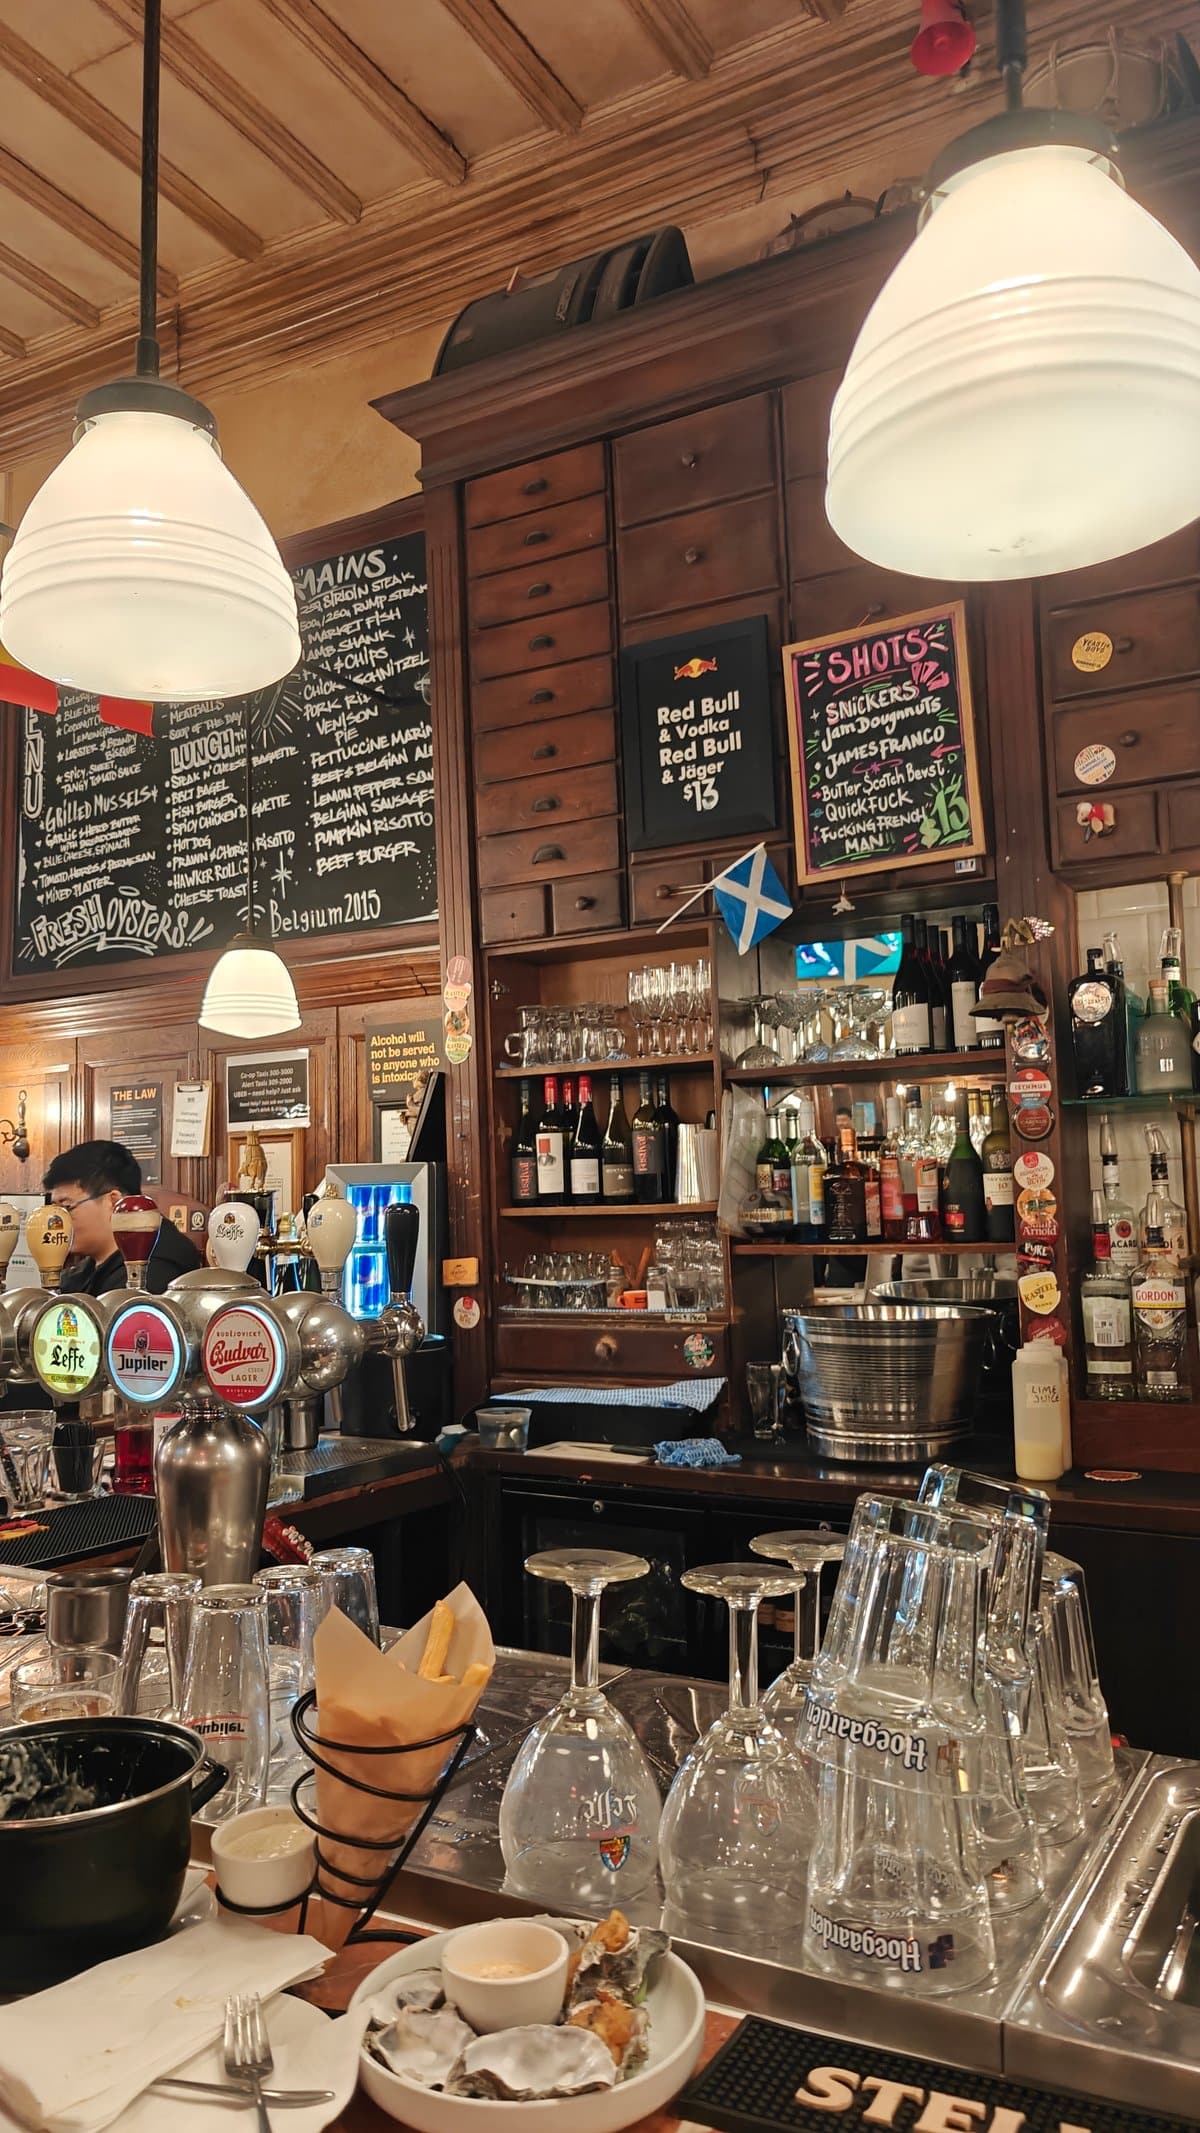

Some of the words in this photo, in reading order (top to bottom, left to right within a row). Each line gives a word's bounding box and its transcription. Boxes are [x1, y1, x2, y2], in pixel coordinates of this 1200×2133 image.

[372, 572, 415, 592] STEAK
[353, 595, 388, 615] RUMP
[388, 584, 428, 602] STEAK
[308, 619, 364, 644] MARKET
[366, 607, 401, 629] FISH
[337, 630, 396, 652] SHANK
[345, 646, 388, 667] CHIPS
[827, 628, 929, 684] SHOTS
[304, 675, 351, 700] CHICK
[353, 651, 430, 685] SCHNITZEL
[170, 701, 224, 724] MEATBALLS
[304, 699, 342, 721] PORK
[657, 700, 695, 725] Red
[701, 690, 740, 716] Bull
[826, 680, 920, 725] SNICKERS
[225, 711, 242, 726] DAY
[316, 705, 378, 735] VENISON
[659, 728, 671, 743] &
[675, 718, 730, 739] Vodka
[335, 727, 359, 746] PIE
[660, 740, 697, 767] Red
[703, 731, 742, 757] Bull
[821, 722, 856, 752] Jam
[24, 705, 44, 819] ENU
[65, 744, 98, 761] LOBSTER
[170, 728, 236, 774] LUNCH
[310, 736, 390, 769] FETTUCCINE
[825, 741, 879, 779] JAMES
[879, 725, 945, 760] FRANCO
[61, 779, 89, 795] TANGY
[117, 762, 142, 778] SAUCE
[312, 768, 345, 787] BEEF
[355, 748, 408, 776] BELGIAN
[661, 769, 674, 784] &
[678, 760, 725, 781] Jäger
[196, 779, 229, 799] BAGEL
[313, 786, 352, 808] LEMON
[352, 777, 404, 800] PEPPER
[683, 777, 719, 812] $13
[821, 781, 862, 802] Butter
[45, 799, 92, 832] GRILLED
[93, 785, 153, 817] MUSSELS
[172, 804, 195, 822] FISH
[195, 792, 238, 815] BURGER
[310, 802, 368, 828] BELGIAN
[45, 827, 77, 848] GARLIC
[171, 819, 198, 836] SPICY
[199, 811, 237, 830] CHICKEN
[315, 819, 371, 852] PUMPKIN
[373, 811, 433, 835] RISOTTO
[42, 854, 63, 868] BLUE
[95, 837, 131, 855] SPINACH
[172, 851, 208, 871] PRAWN
[216, 840, 254, 860] CHORIZ
[255, 830, 296, 851] RISOTTO
[316, 852, 354, 876] BEEF
[356, 841, 420, 866] BURGER
[173, 869, 213, 890] HAWKER
[215, 862, 239, 879] ROLL
[45, 886, 72, 905] MIXED
[72, 876, 115, 897] PLATTER
[174, 889, 214, 909] CHEESE
[215, 880, 258, 901] TOASTE
[30, 893, 106, 957] FRESH
[370, 1032, 407, 1047] Alcohol
[408, 1031, 425, 1043] will
[371, 1047, 387, 1059] not
[388, 1047, 401, 1057] be
[402, 1042, 435, 1056] served
[371, 1061, 381, 1071] to
[383, 1059, 417, 1072] anyone
[419, 1055, 440, 1067] who
[371, 1072, 380, 1084] is
[382, 1070, 427, 1083] intoxica
[112, 1089, 133, 1102] THE
[134, 1087, 157, 1100] LAW
[41, 1232, 69, 1245] Leffe
[216, 1224, 244, 1240] Leffe
[1022, 1223, 1057, 1236] Arnold
[1111, 1240, 1137, 1248] ACARD
[1023, 1282, 1054, 1302] KASTEEL
[50, 1344, 85, 1372] Leffe
[117, 1353, 168, 1373] Jupiler
[210, 1340, 268, 1367] Budvar
[231, 1374, 258, 1382] LAGER
[1031, 1385, 1057, 1394] LIME
[806, 1700, 928, 1772] Hoegaarden
[809, 1907, 923, 1972] Hoegaarden
[795, 2066, 1093, 2133] STEL
